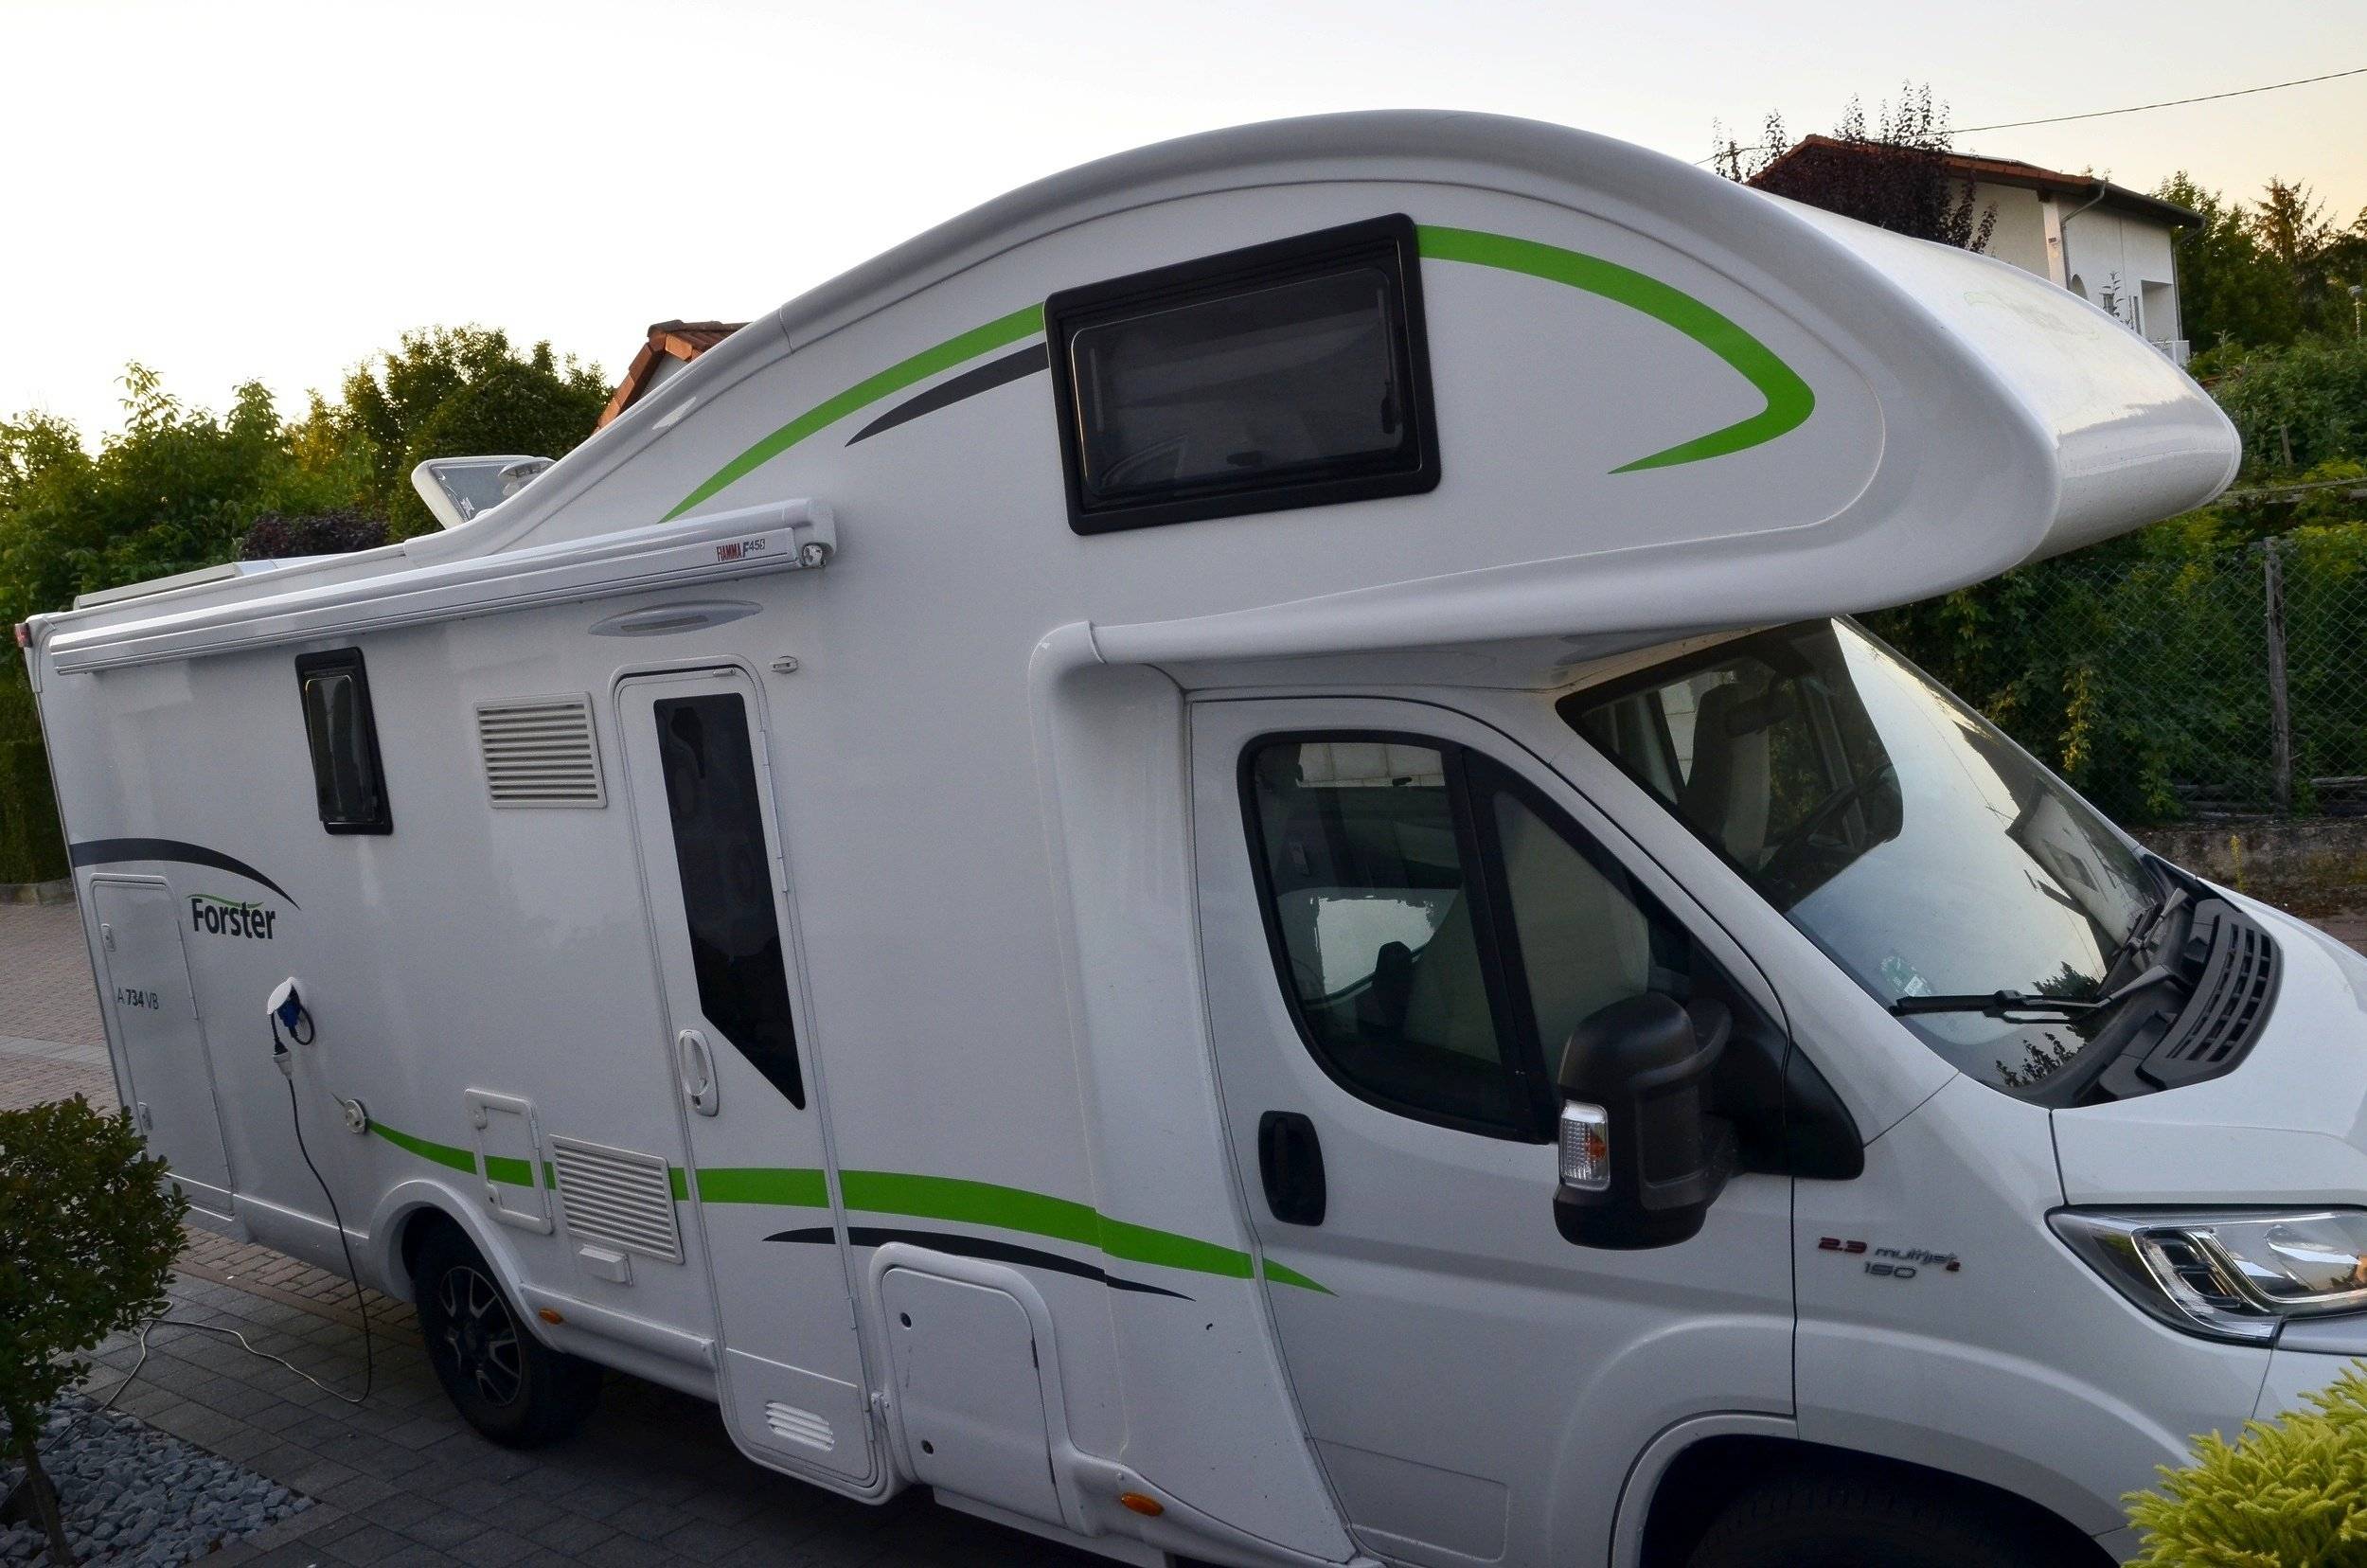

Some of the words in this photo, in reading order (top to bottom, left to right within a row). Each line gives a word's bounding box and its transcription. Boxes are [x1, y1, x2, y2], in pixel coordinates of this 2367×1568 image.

[717, 543, 742, 561] FIAMMA
[191, 898, 276, 939] Forster
[117, 987, 125, 1004] A
[125, 989, 144, 1007] 734
[145, 991, 159, 1010] VB
[1819, 1237, 1868, 1254] 2.3
